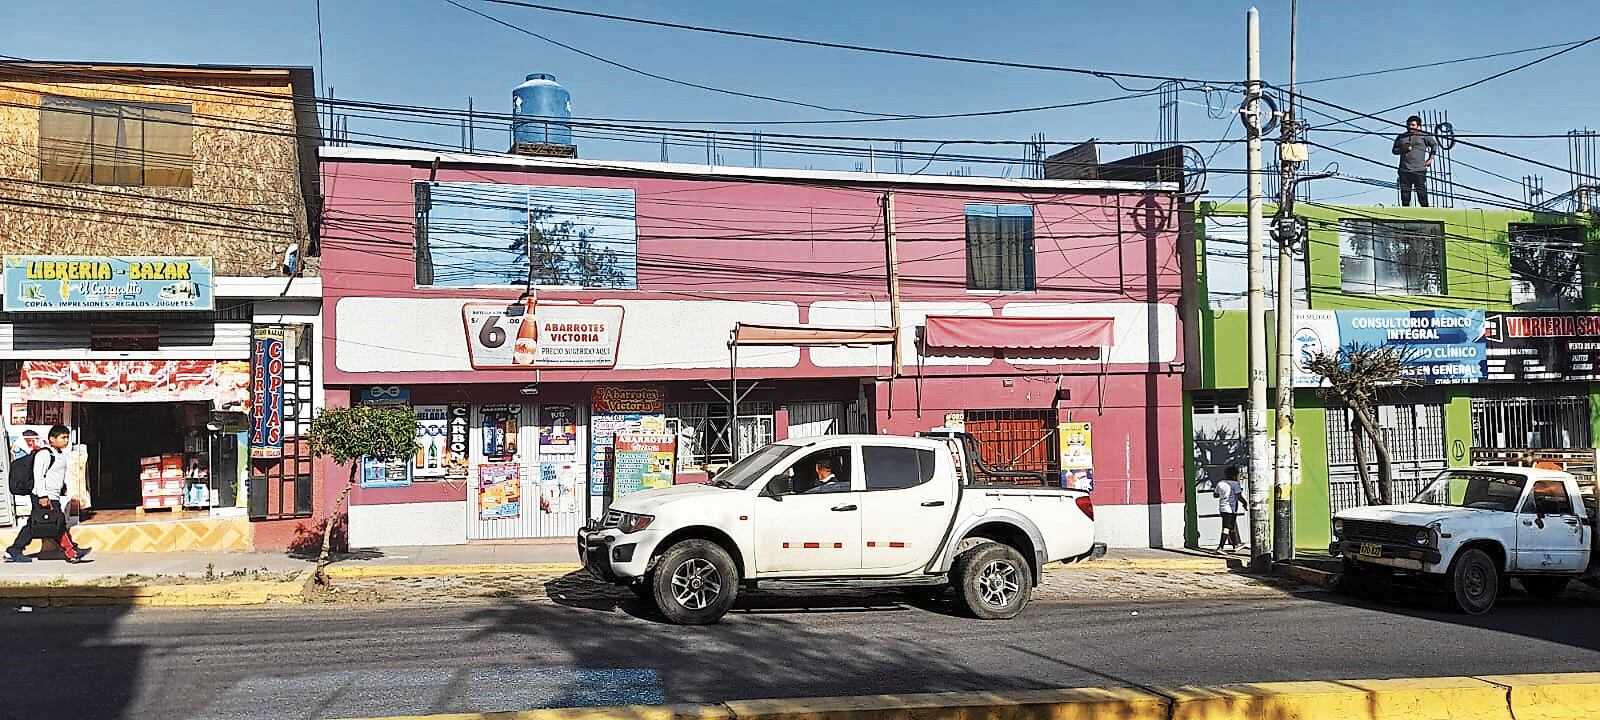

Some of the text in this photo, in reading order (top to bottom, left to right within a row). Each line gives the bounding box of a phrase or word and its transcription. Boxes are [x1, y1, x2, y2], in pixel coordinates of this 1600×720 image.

[27, 261, 113, 280] LIBRERIA
[129, 261, 191, 280] BAZAR
[545, 323, 605, 332] ABARROTES
[1351, 314, 1472, 328] CONSULTORIO MÉDICO
[1506, 317, 1577, 337] VIDRIERIA
[479, 315, 506, 348] 6
[551, 333, 599, 342] VICTORIA
[1387, 328, 1440, 340] INTEGRAL
[1434, 344, 1477, 358] CLÍNICO
[1432, 364, 1477, 375] GENERAL
[252, 341, 265, 444] LIBRERIA
[267, 341, 283, 445] COPIAS
[604, 388, 658, 400] Abarrotes
[609, 402, 651, 412] Victoria
